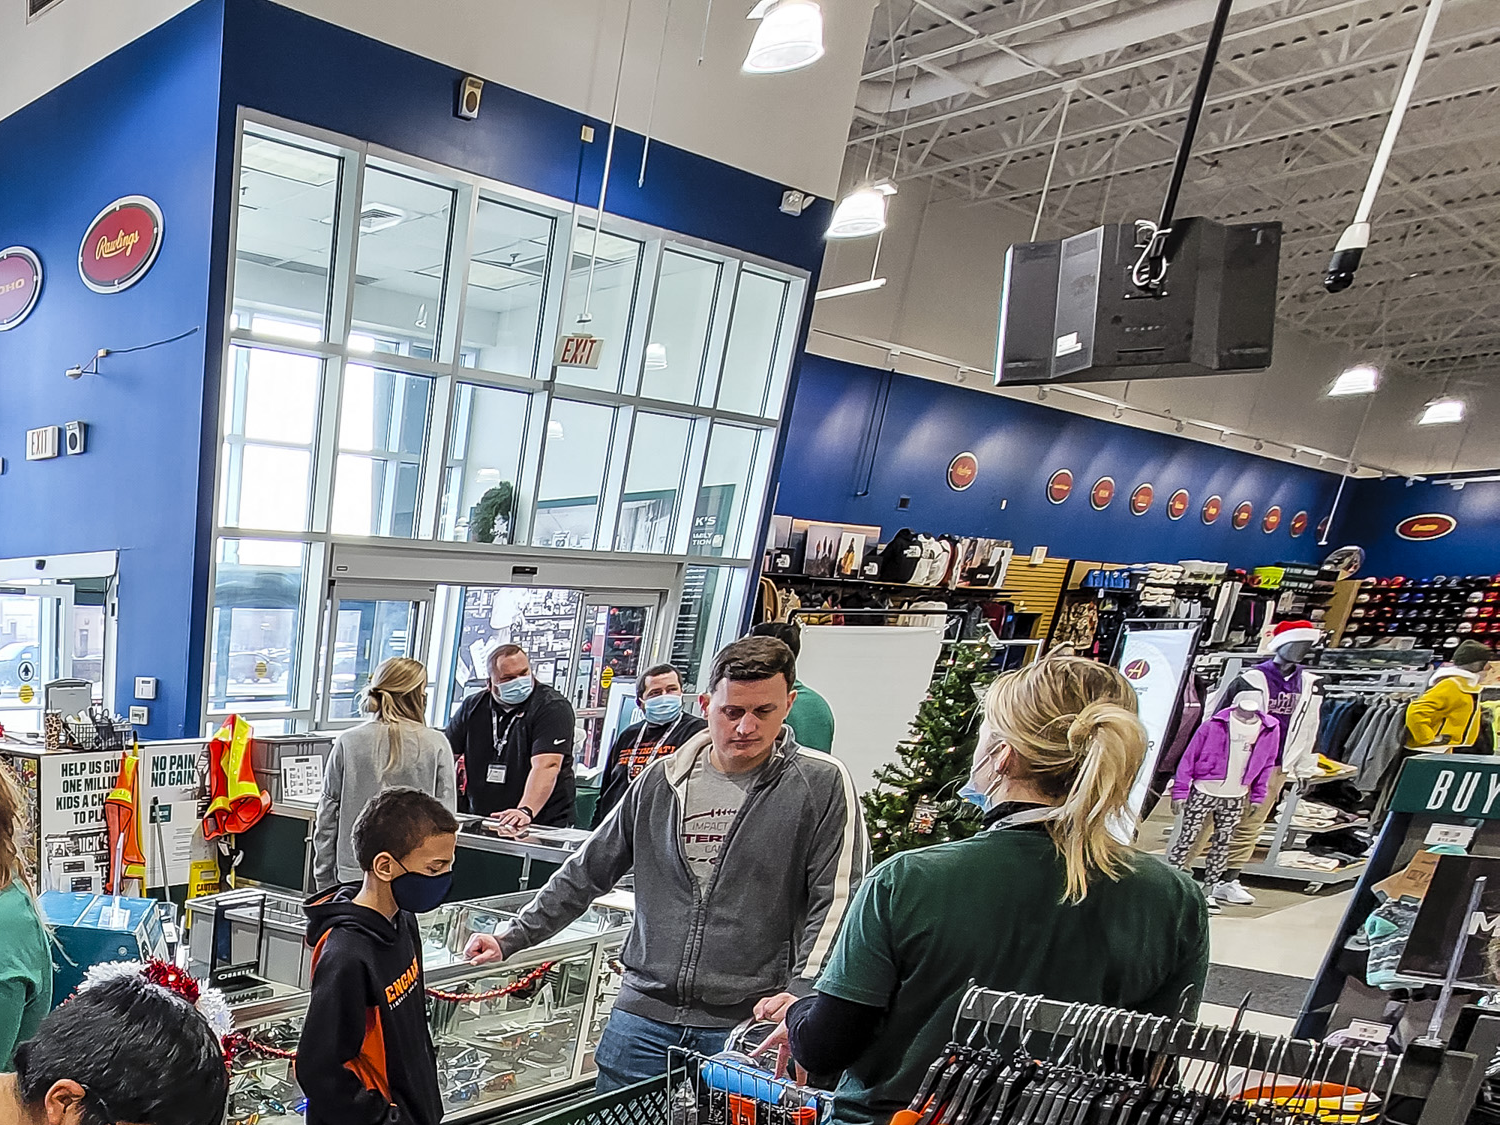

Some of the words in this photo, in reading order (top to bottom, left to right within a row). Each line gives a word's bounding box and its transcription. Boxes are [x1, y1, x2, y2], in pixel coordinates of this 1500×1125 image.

[96, 230, 140, 260] Rawlings
[561, 338, 596, 364] EXIT
[32, 430, 47, 455] EXIT
[62, 762, 86, 777] HELP
[89, 761, 101, 774] US
[152, 756, 167, 771] NO
[63, 778, 82, 793] ONE
[151, 772, 166, 787] NO
[56, 795, 80, 810] KIDS
[82, 795, 89, 807] A
[73, 811, 88, 824] TO
[692, 821, 728, 831] IMPACT
